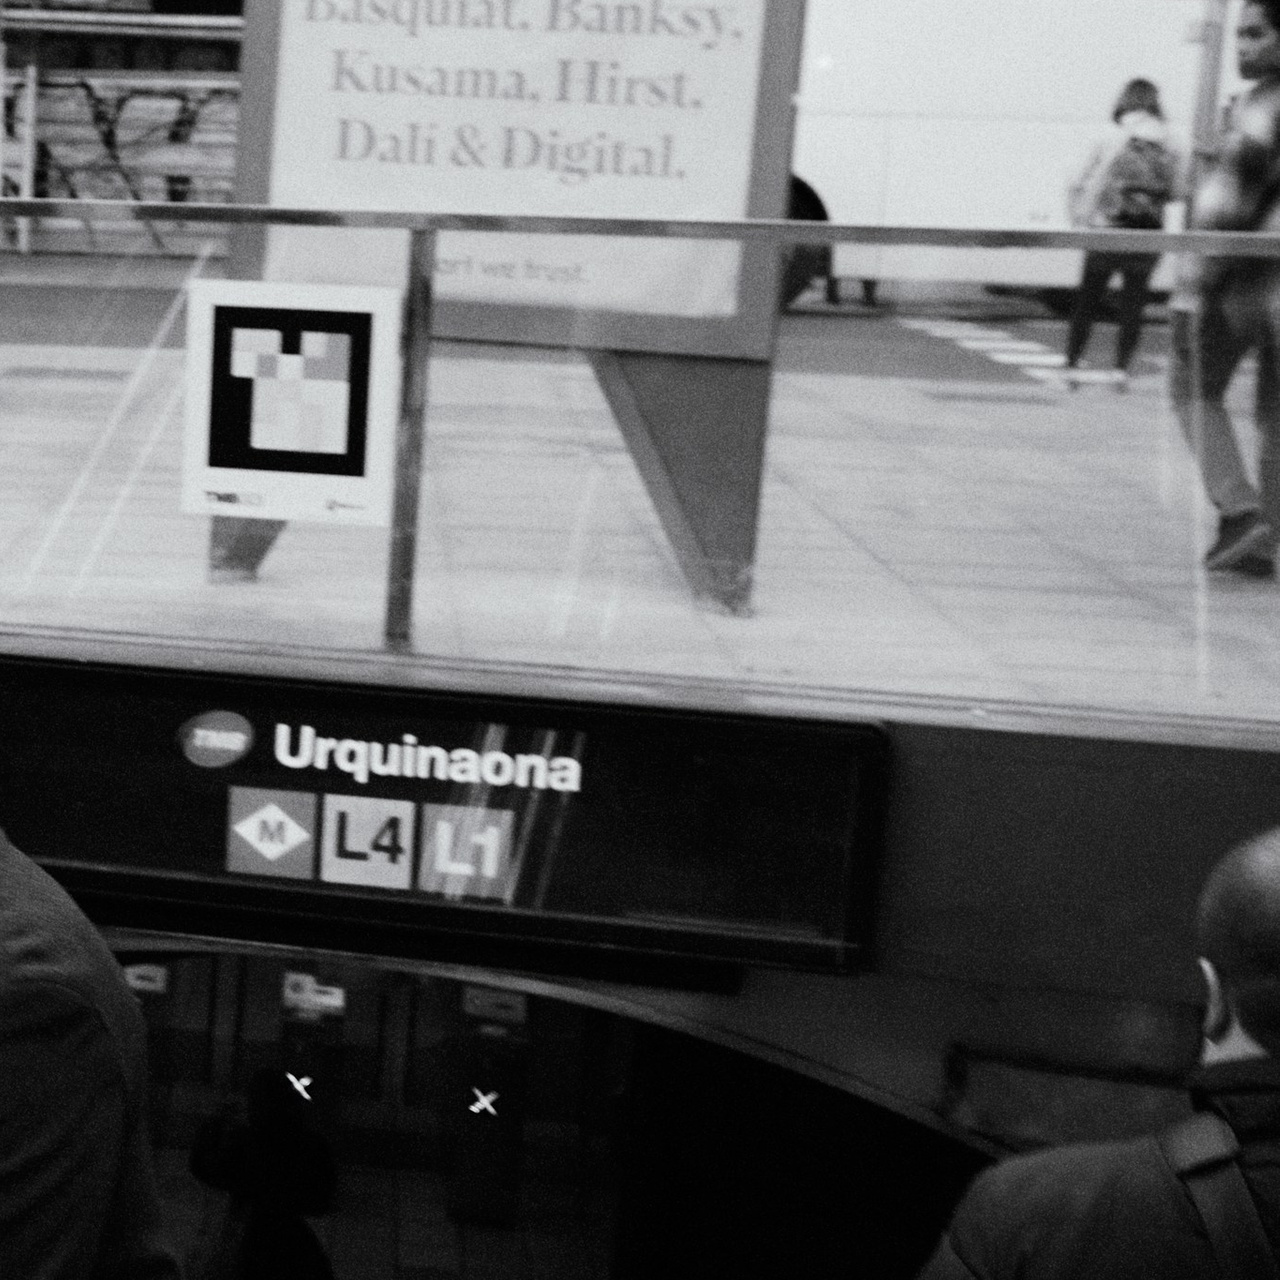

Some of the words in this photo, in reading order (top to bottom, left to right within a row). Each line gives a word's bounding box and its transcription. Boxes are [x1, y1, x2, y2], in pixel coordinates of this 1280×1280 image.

[450, 124, 486, 168] &
[274, 723, 582, 792] Urquinaona
[257, 818, 287, 845] M
[335, 811, 405, 865] L4
[434, 821, 499, 879] L1
